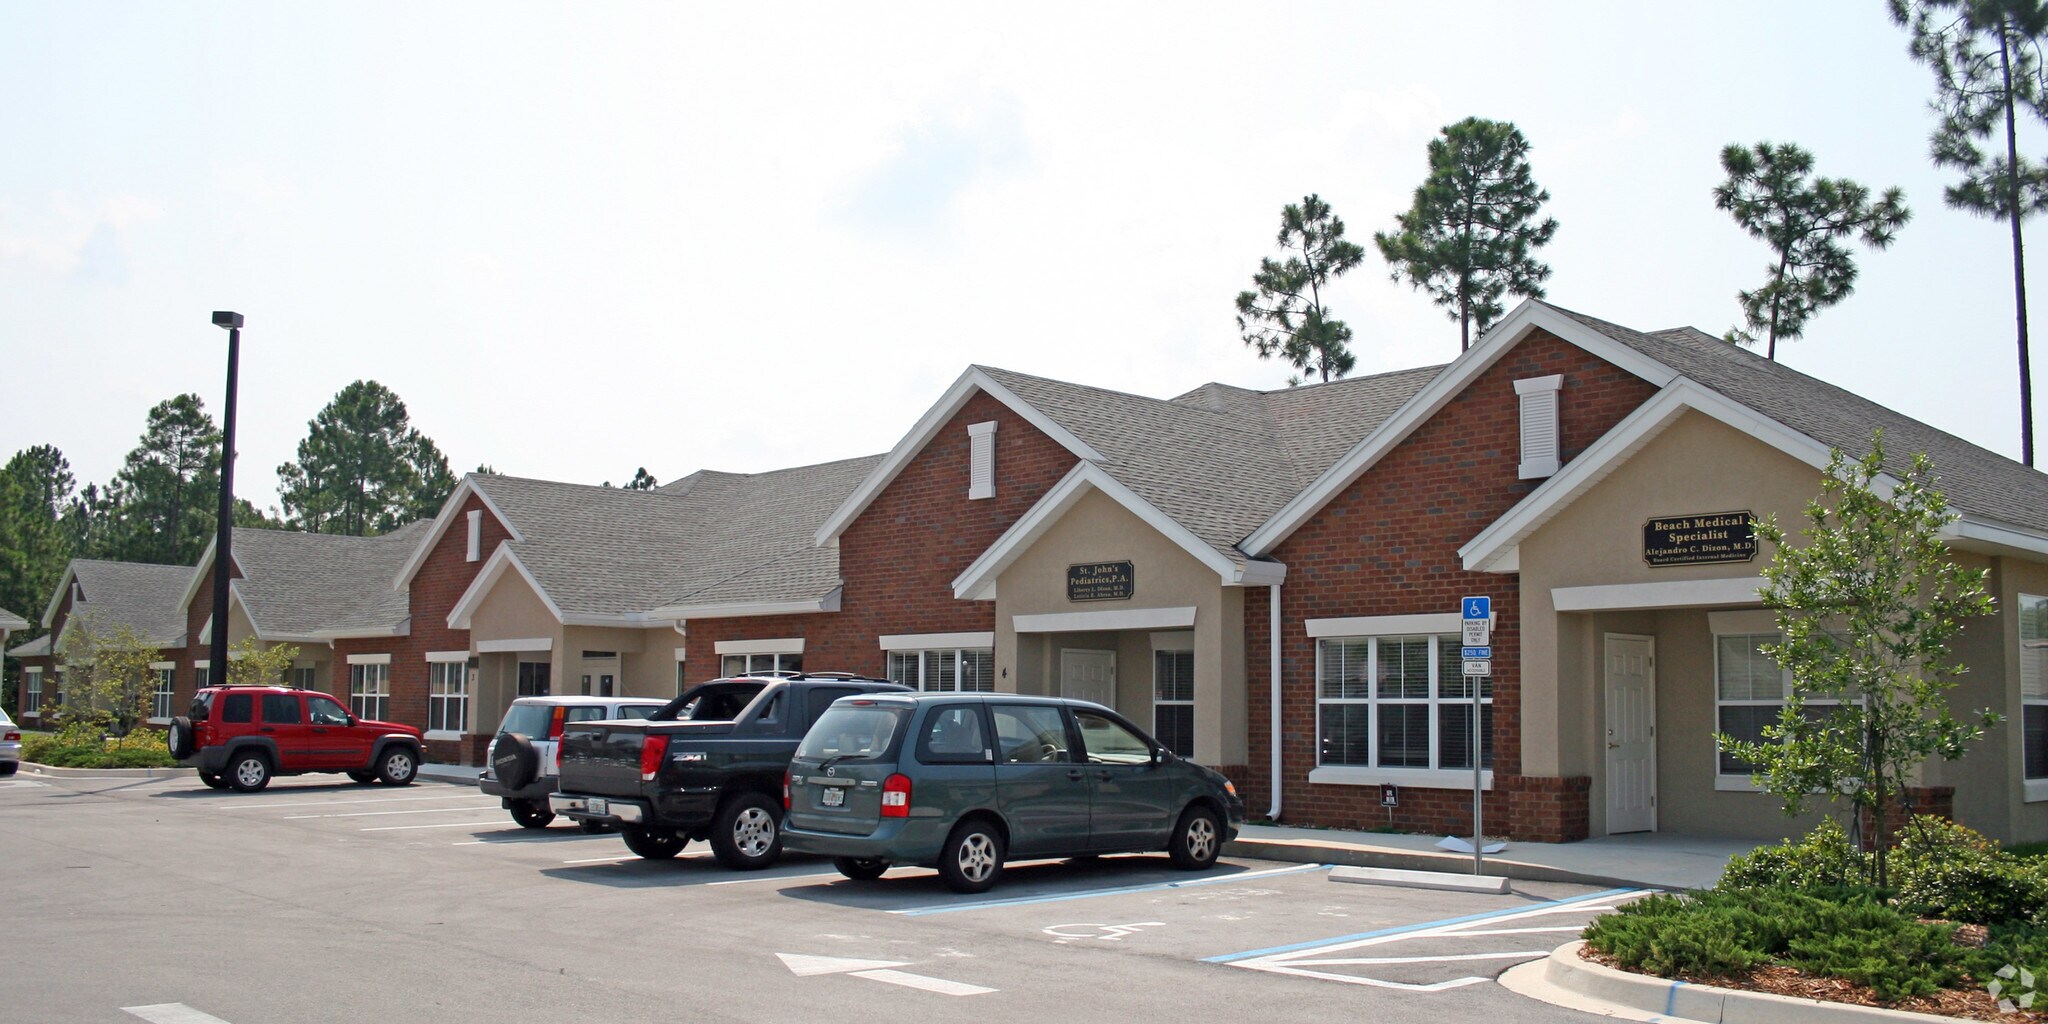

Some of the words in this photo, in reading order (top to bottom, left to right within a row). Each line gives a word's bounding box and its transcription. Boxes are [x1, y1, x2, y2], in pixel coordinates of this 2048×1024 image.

[1655, 520, 1690, 531] Beach
[1694, 516, 1743, 528] Medical
[1669, 530, 1728, 544] Specialist
[1645, 547, 1687, 556] Alejandro
[1702, 544, 1730, 552] Dizon,
[1733, 542, 1754, 550] M.D.
[1079, 566, 1090, 574] St.
[1092, 565, 1119, 576] John's
